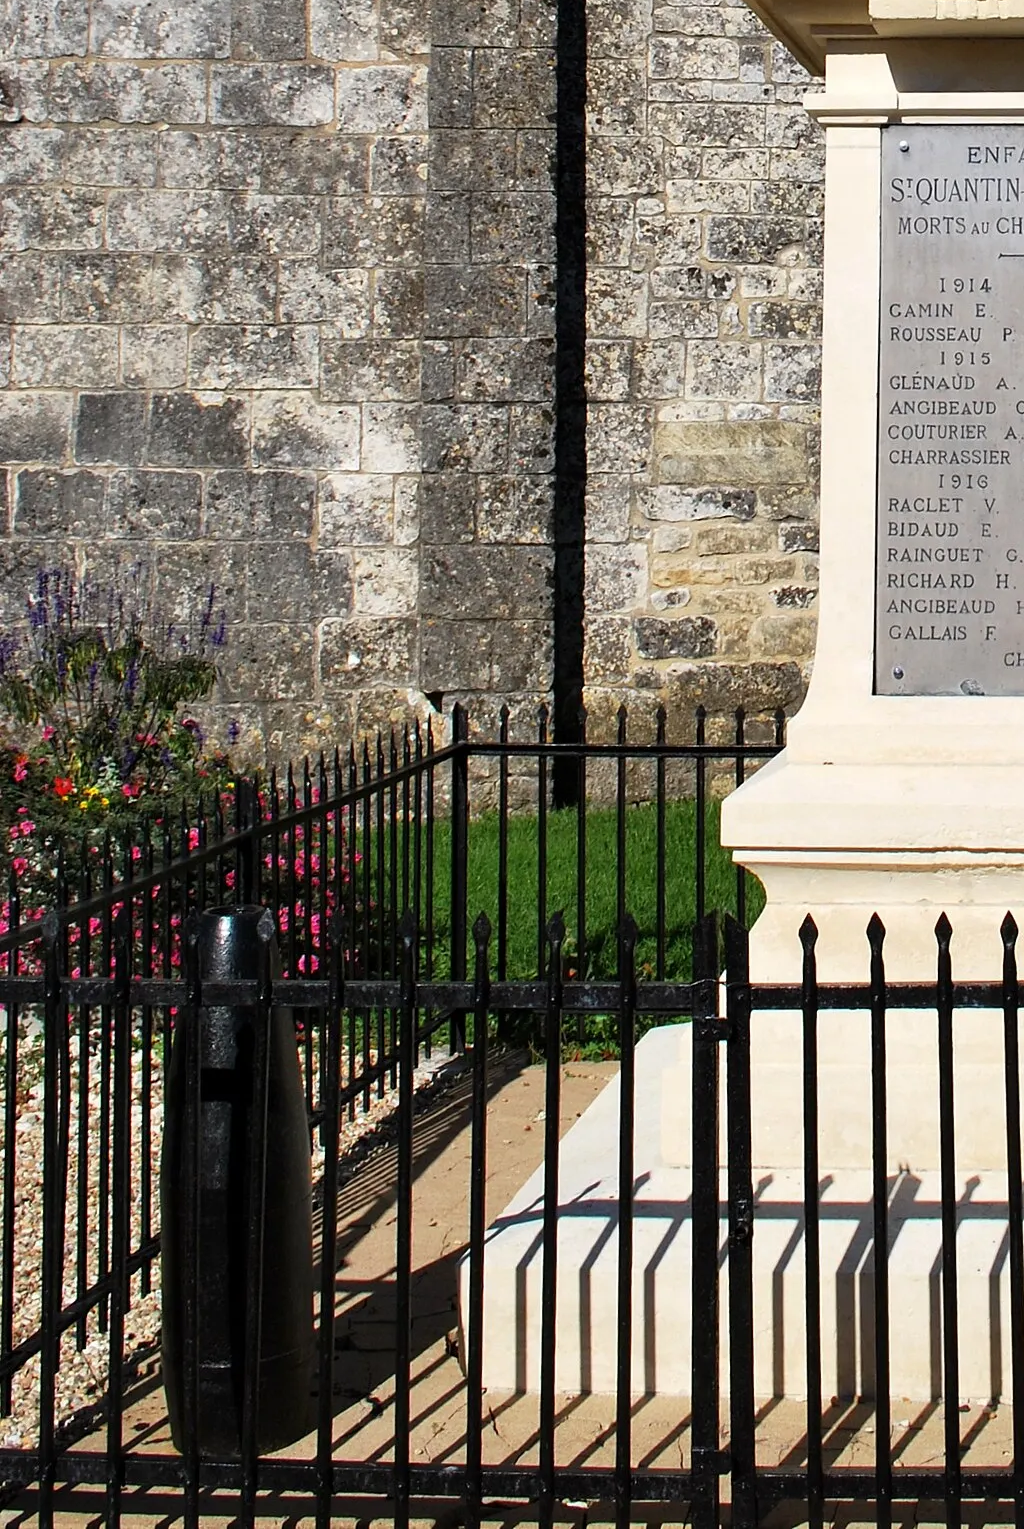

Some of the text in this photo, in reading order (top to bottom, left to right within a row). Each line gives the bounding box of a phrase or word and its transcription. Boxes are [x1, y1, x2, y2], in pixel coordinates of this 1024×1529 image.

[897, 216, 966, 235] MORTS
[971, 221, 990, 235] AU
[939, 278, 993, 293] 1914
[975, 303, 994, 318] E.
[890, 327, 1016, 342] ROUSSEAU P.
[940, 351, 991, 366] 1915
[996, 377, 1017, 391] A.
[889, 400, 997, 416] ANGIBEAUD
[887, 424, 1024, 441] COUTURIER A.
[888, 449, 1011, 465] CHARRASSIER
[938, 474, 989, 489] 1916
[888, 497, 1000, 514] RACLET V.
[888, 522, 999, 538] BIDAUD E.
[887, 548, 1024, 563] RAINGUET G.
[887, 573, 1017, 590] RICHARD H.
[886, 599, 996, 615] ANGIBEAUD
[888, 624, 997, 641] GALLAIS F.
